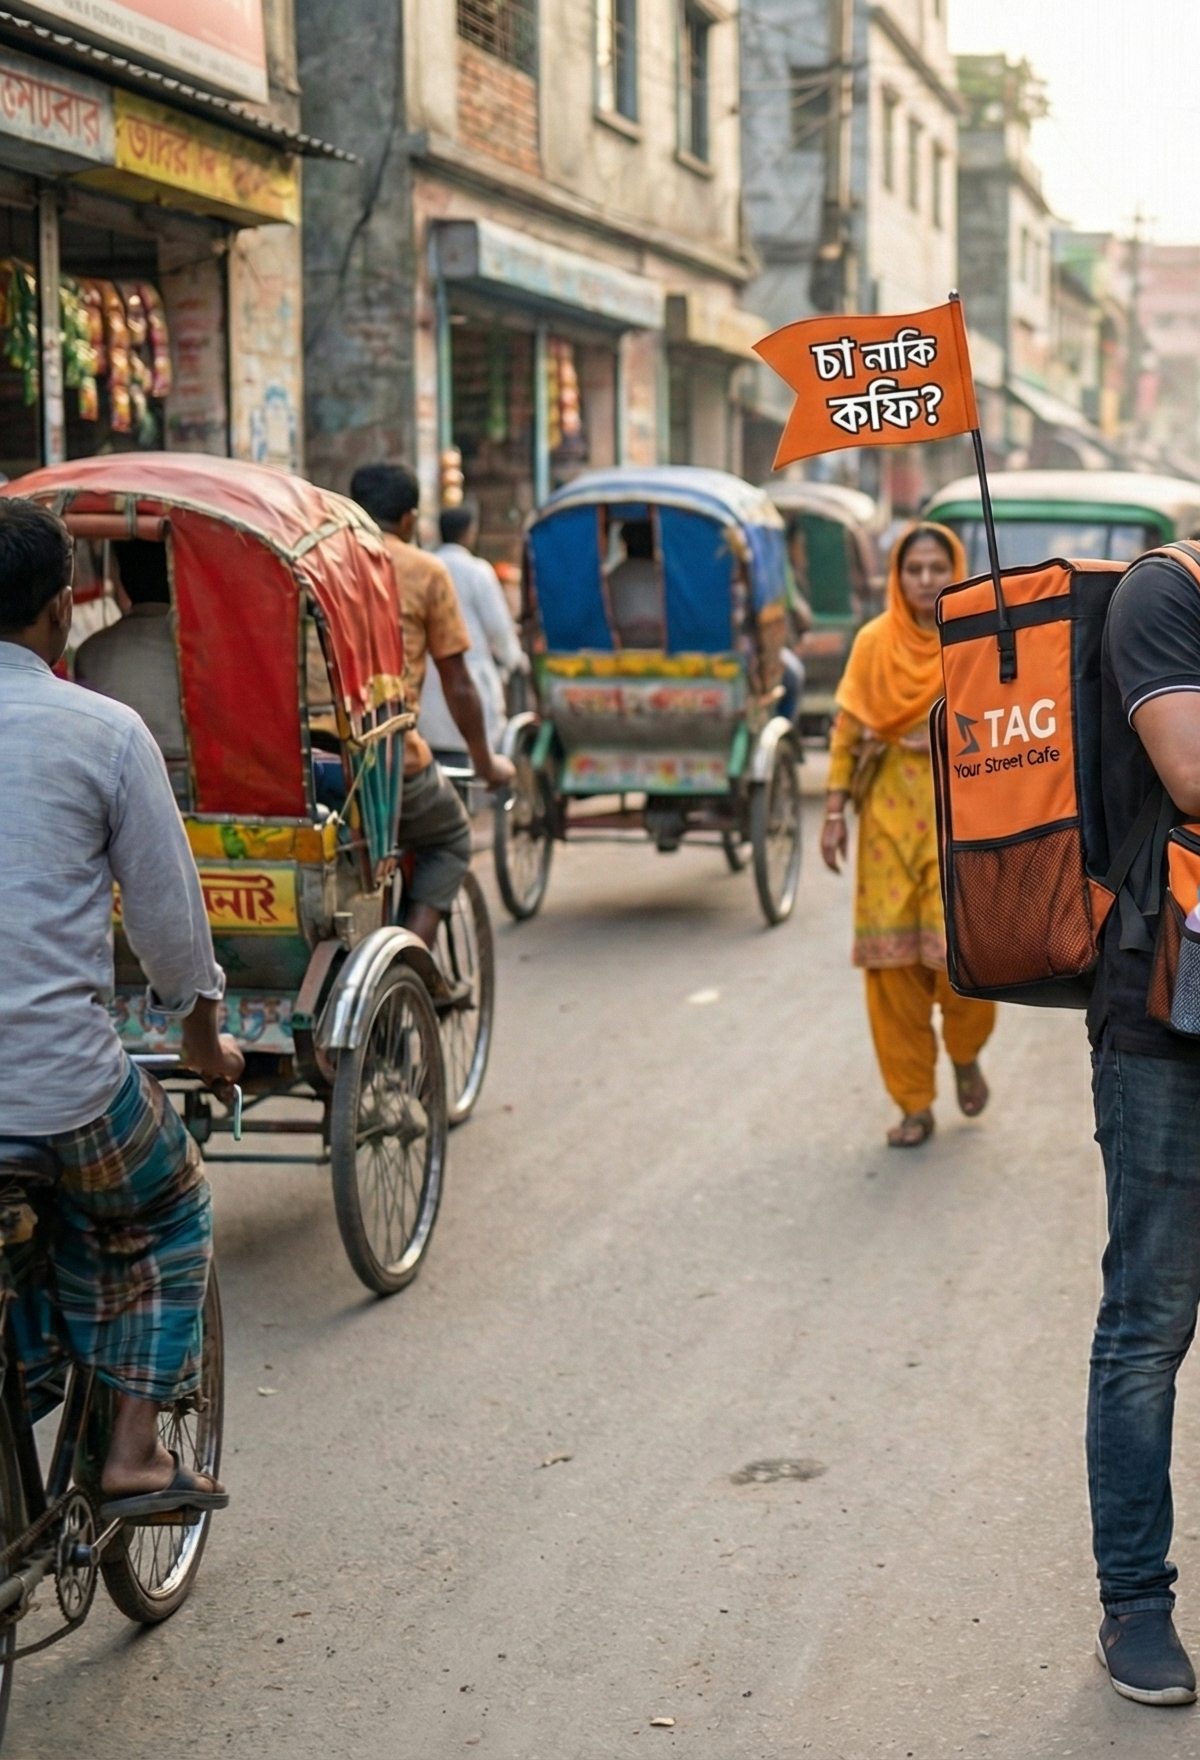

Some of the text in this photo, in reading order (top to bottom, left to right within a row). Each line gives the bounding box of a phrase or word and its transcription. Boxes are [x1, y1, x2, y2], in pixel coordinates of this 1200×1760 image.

[810, 327, 936, 380] চা নাকি
[827, 378, 942, 433] কফি?
[984, 698, 1056, 748] TAG
[953, 746, 1060, 779] Your Street Cafe
